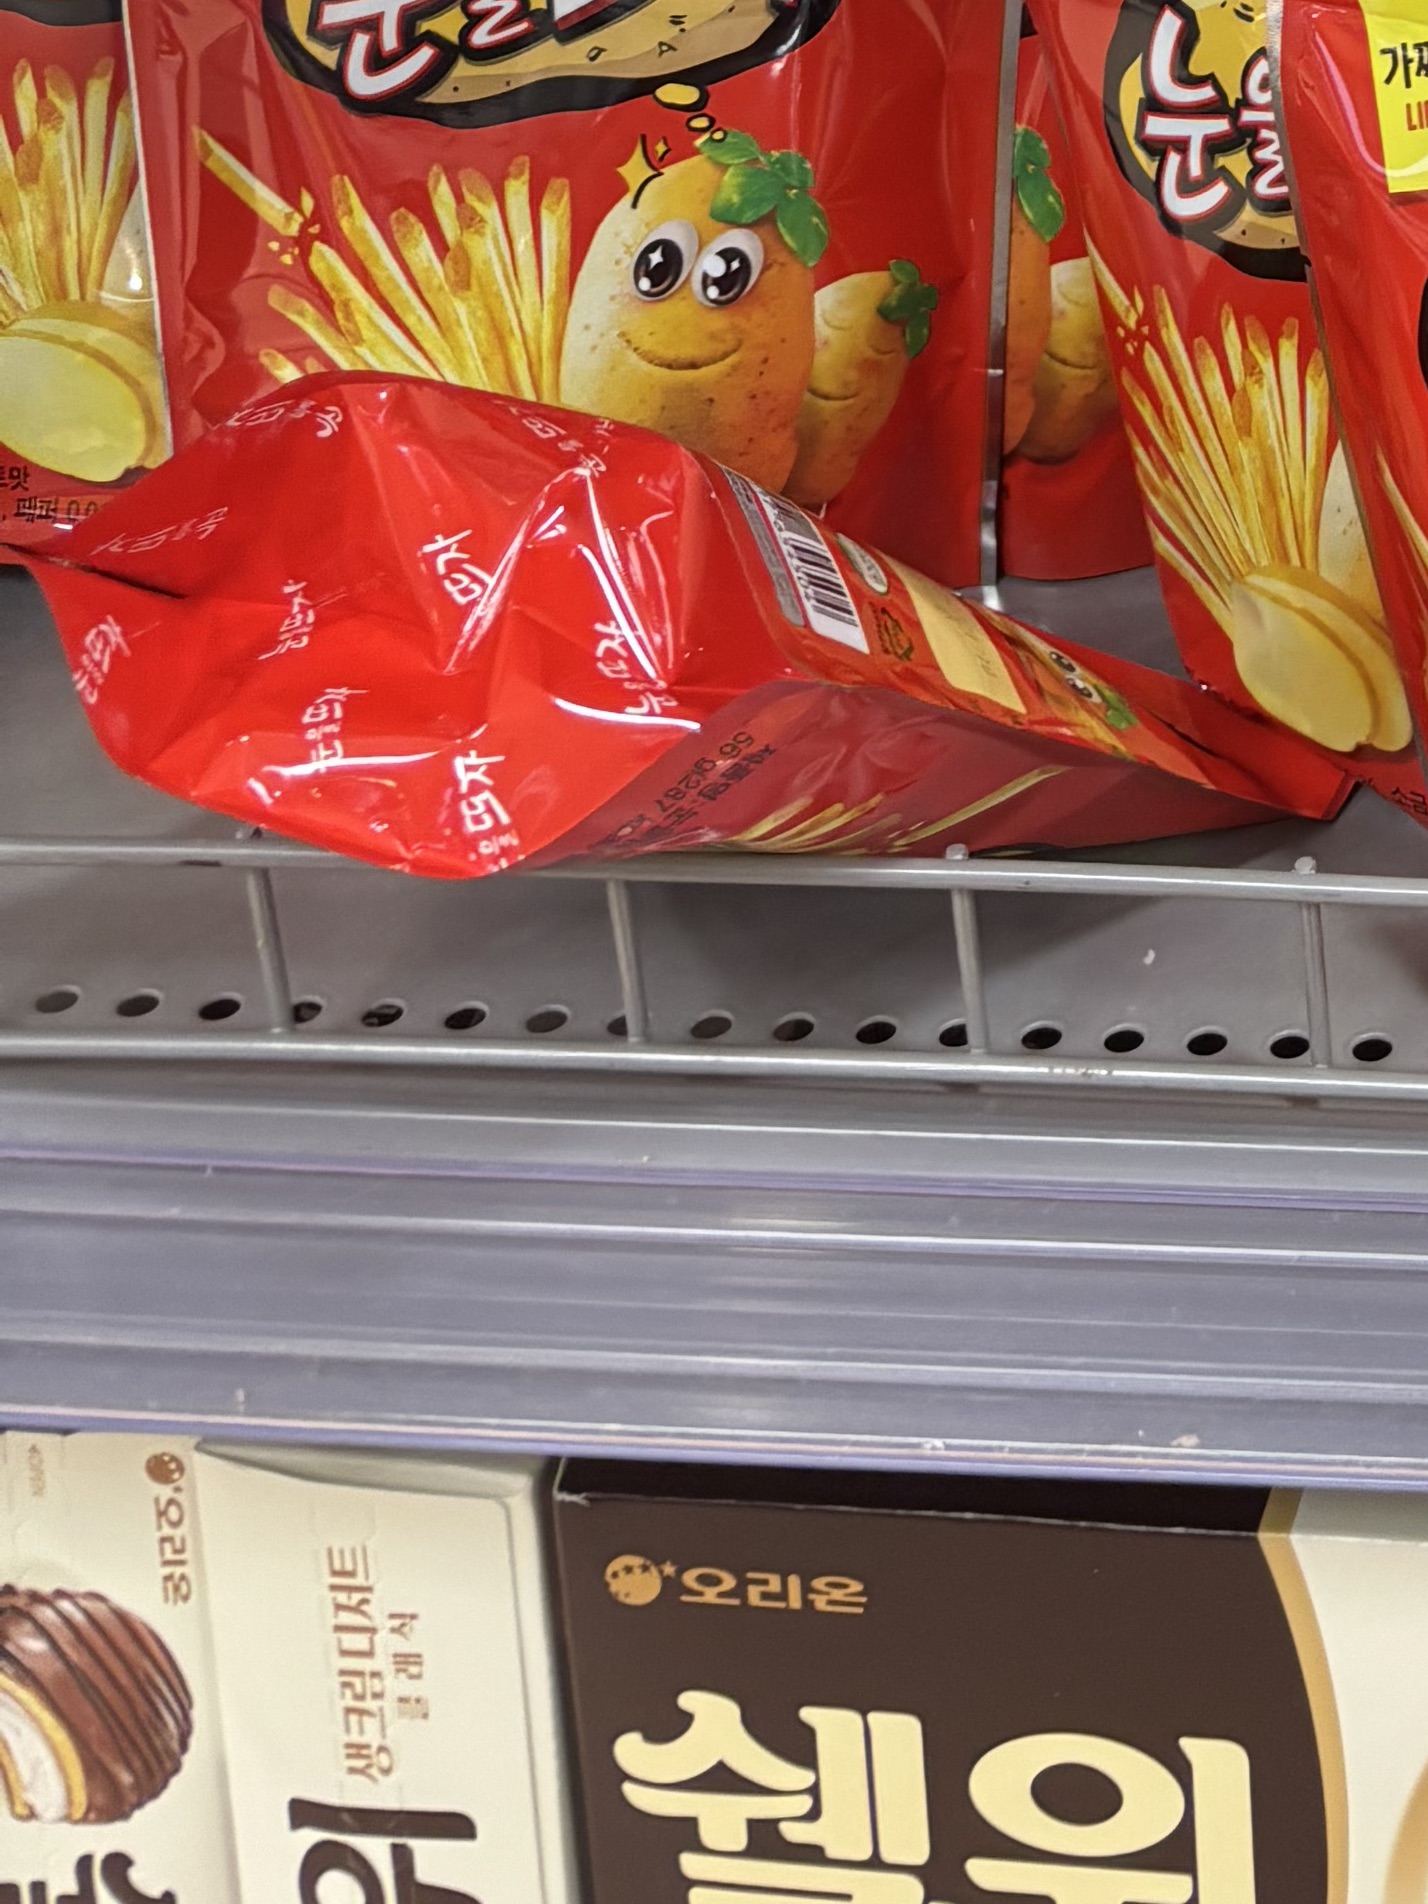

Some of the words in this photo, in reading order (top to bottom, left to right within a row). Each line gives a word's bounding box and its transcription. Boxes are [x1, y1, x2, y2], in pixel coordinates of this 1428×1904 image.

[160, 1494, 192, 1606] 오리온
[326, 1538, 377, 1669] 디저트
[680, 1568, 869, 1615] 오리온
[337, 1676, 394, 1789] 생크림
